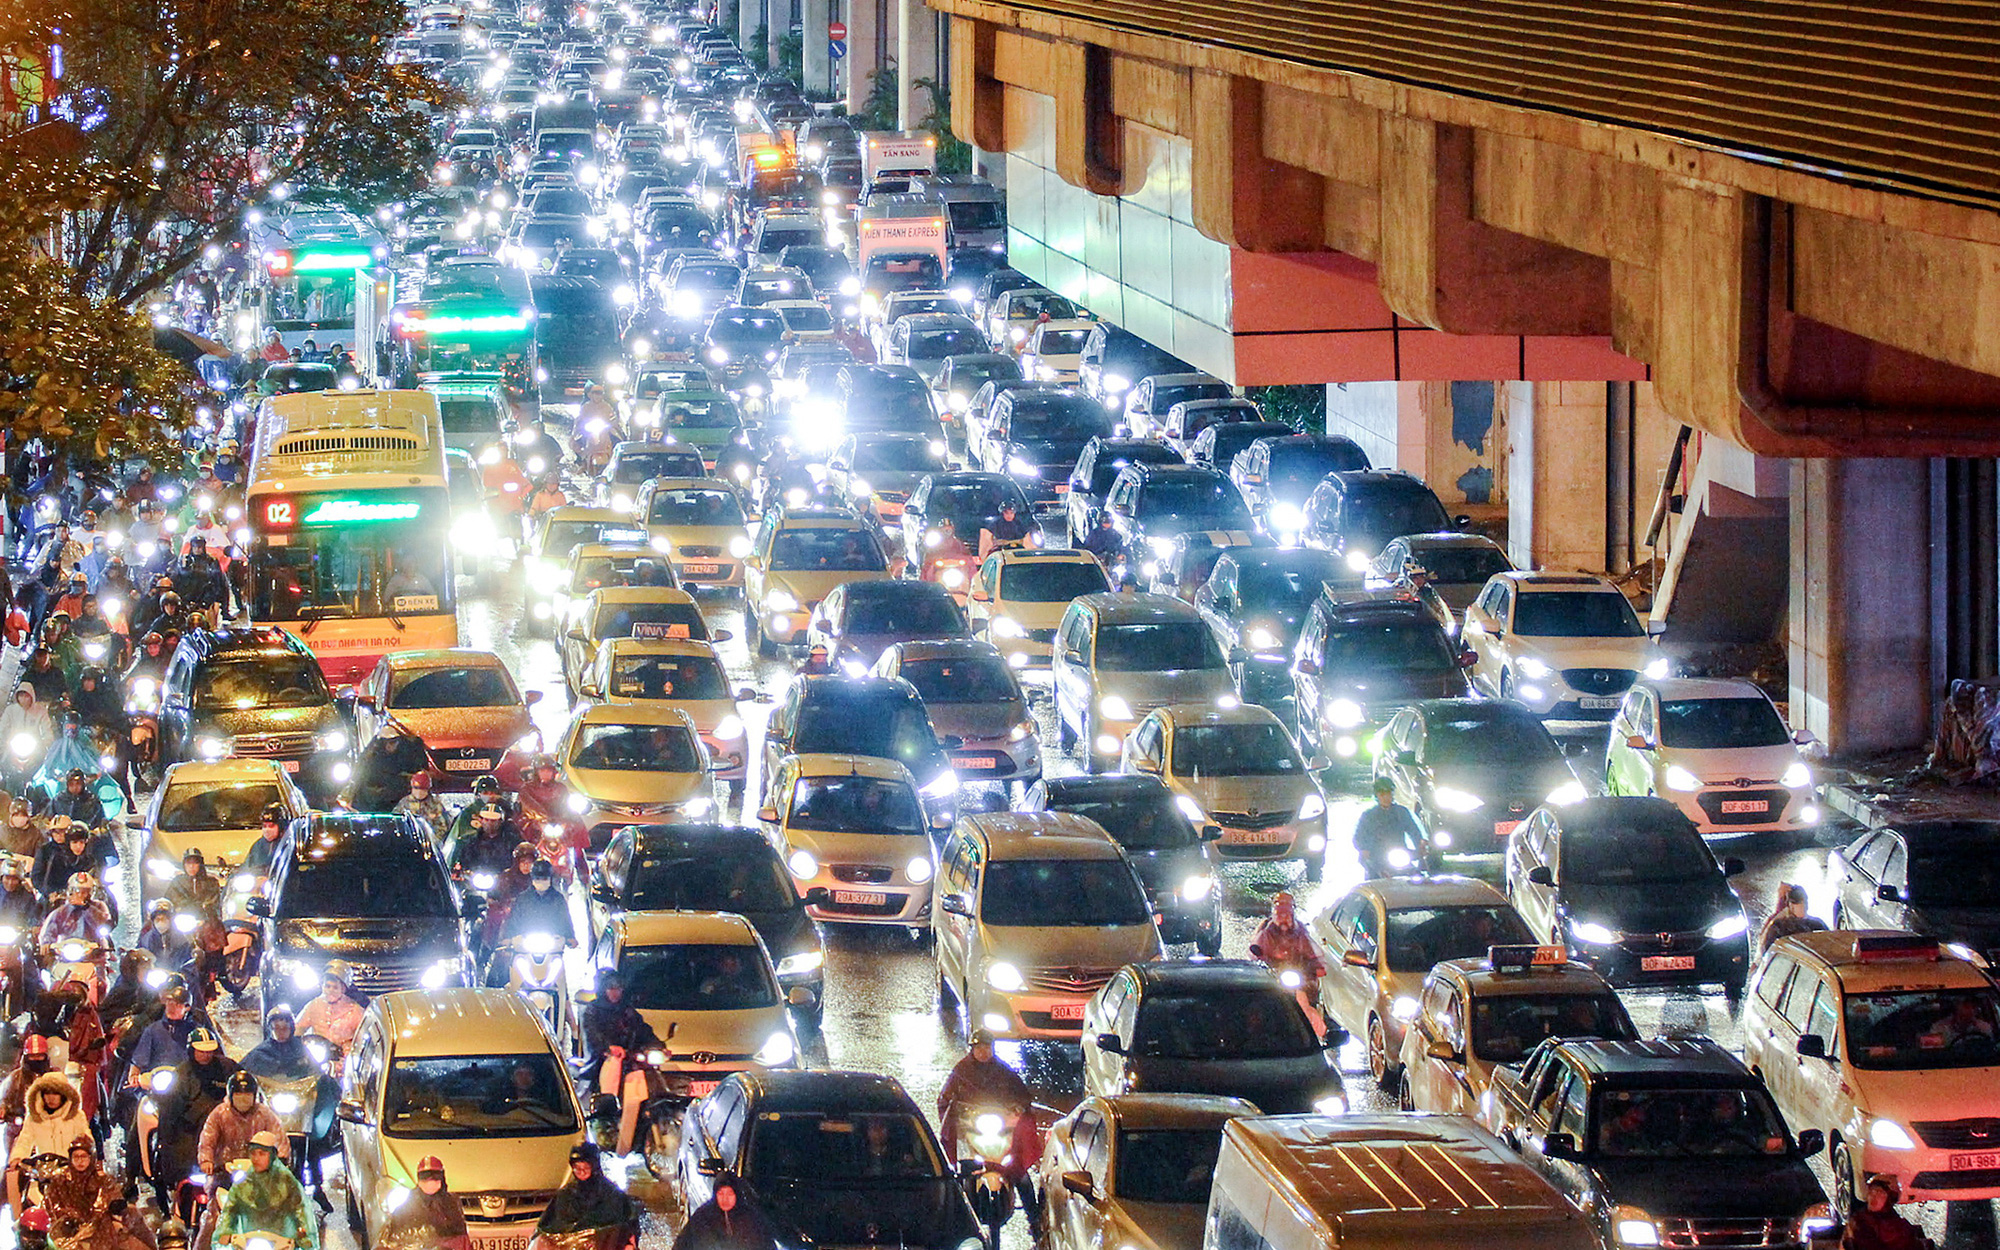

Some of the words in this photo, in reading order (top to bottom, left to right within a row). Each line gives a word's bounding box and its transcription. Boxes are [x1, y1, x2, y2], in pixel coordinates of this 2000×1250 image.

[908, 226, 939, 237] EXPRESS
[267, 502, 292, 523] 02
[1053, 1006, 1085, 1018] 30A-97
[1953, 1154, 2000, 1169] 30A-988
